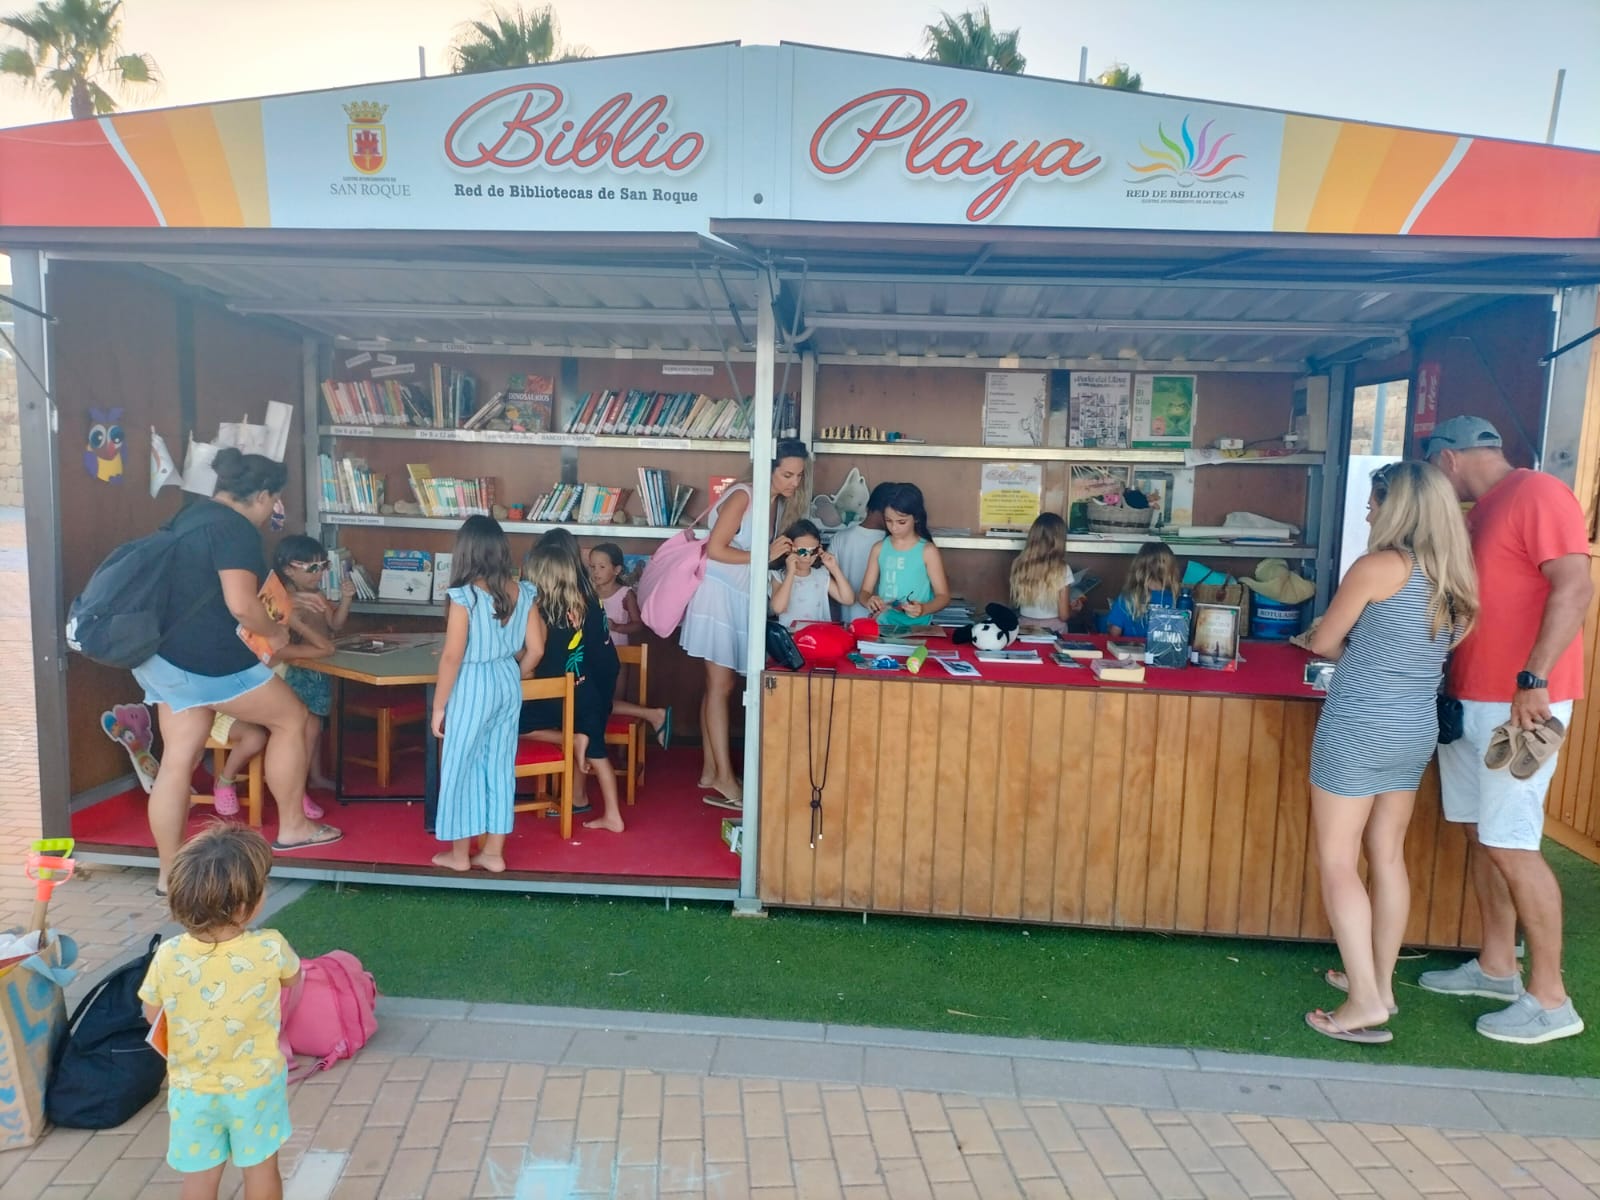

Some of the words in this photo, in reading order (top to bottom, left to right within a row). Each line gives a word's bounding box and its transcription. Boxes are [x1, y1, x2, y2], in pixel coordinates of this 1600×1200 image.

[444, 82, 705, 171] Biblio
[810, 87, 1102, 222] Playa
[330, 183, 357, 196] SAN
[361, 184, 412, 199] ROQUE
[454, 183, 482, 198] Red
[487, 184, 505, 198] de
[509, 184, 593, 200] Bibliotecas
[598, 186, 616, 200] de
[620, 187, 648, 201] San
[652, 188, 698, 204] Roque
[1126, 189, 1150, 198] RED
[1152, 190, 1168, 198] DE
[1170, 190, 1245, 199] BIBLIOTECAS
